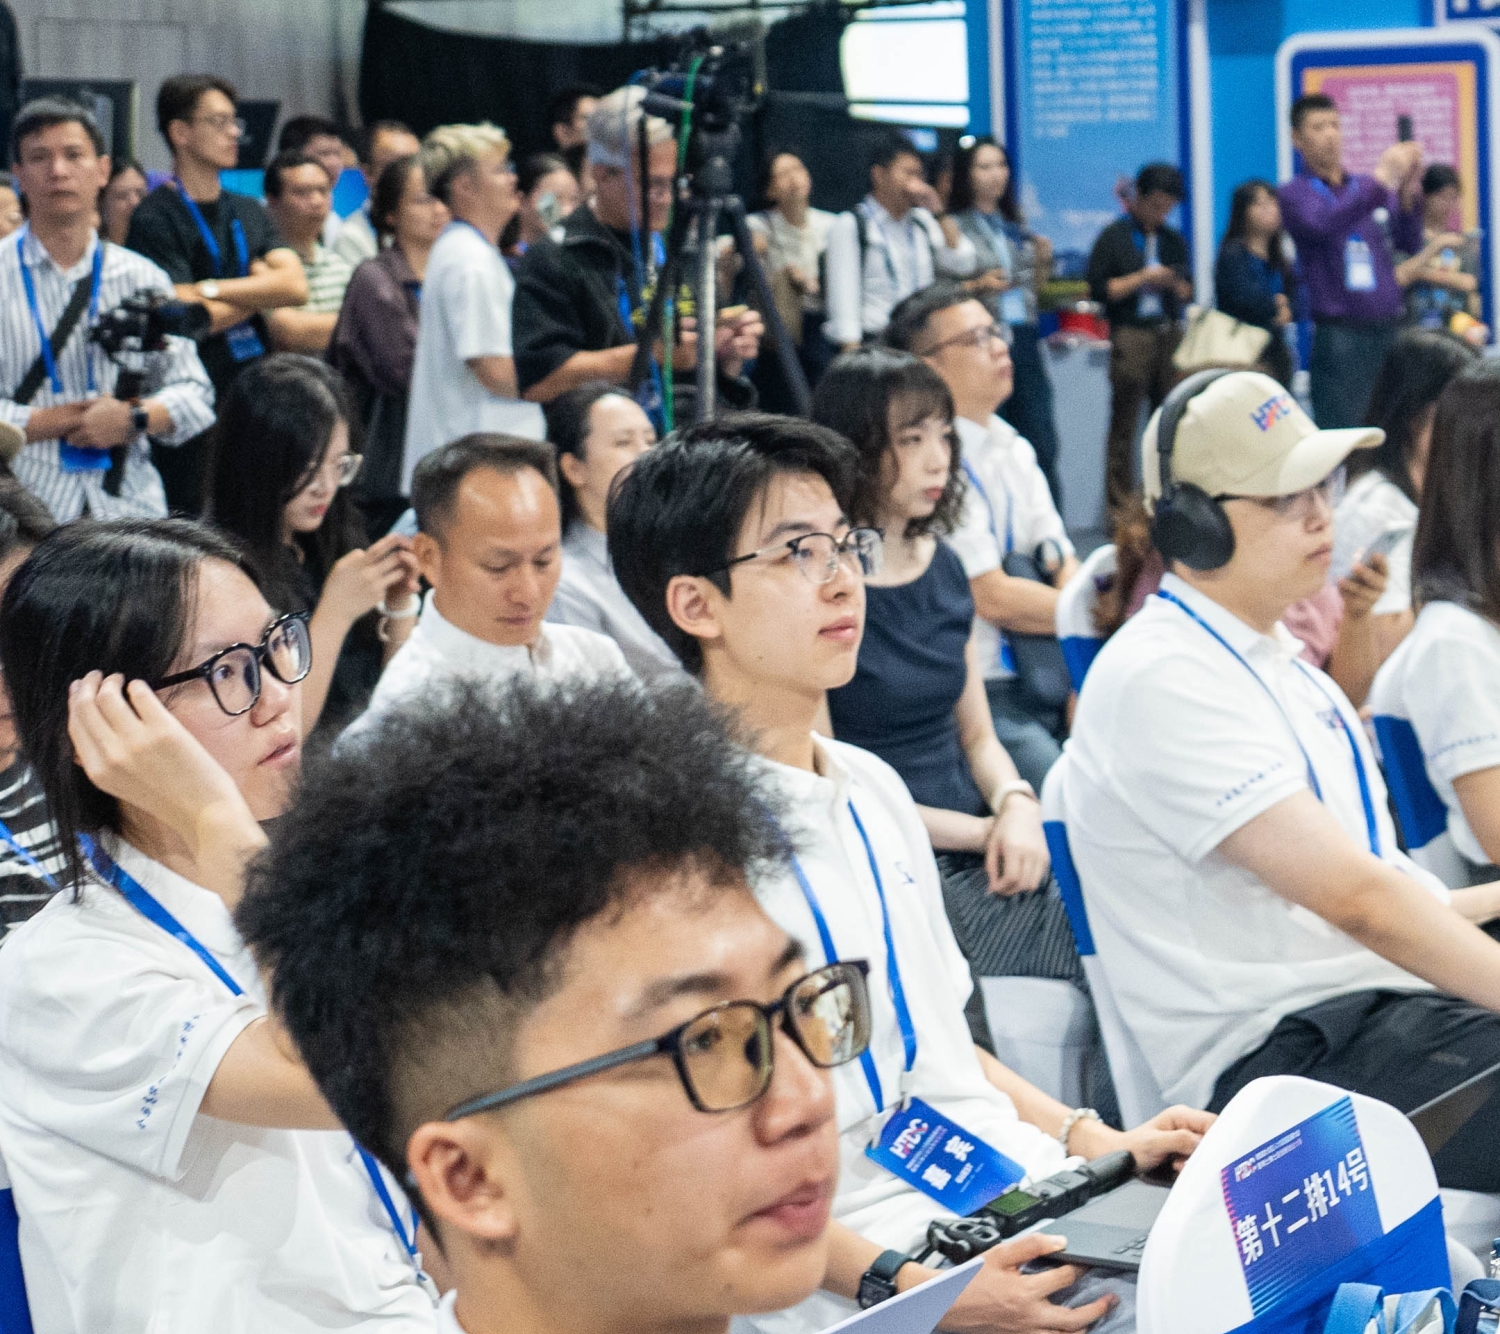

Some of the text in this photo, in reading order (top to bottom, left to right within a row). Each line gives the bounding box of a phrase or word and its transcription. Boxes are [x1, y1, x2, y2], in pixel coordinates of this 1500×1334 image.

[1236, 1146, 1369, 1267] 第十二排14号
